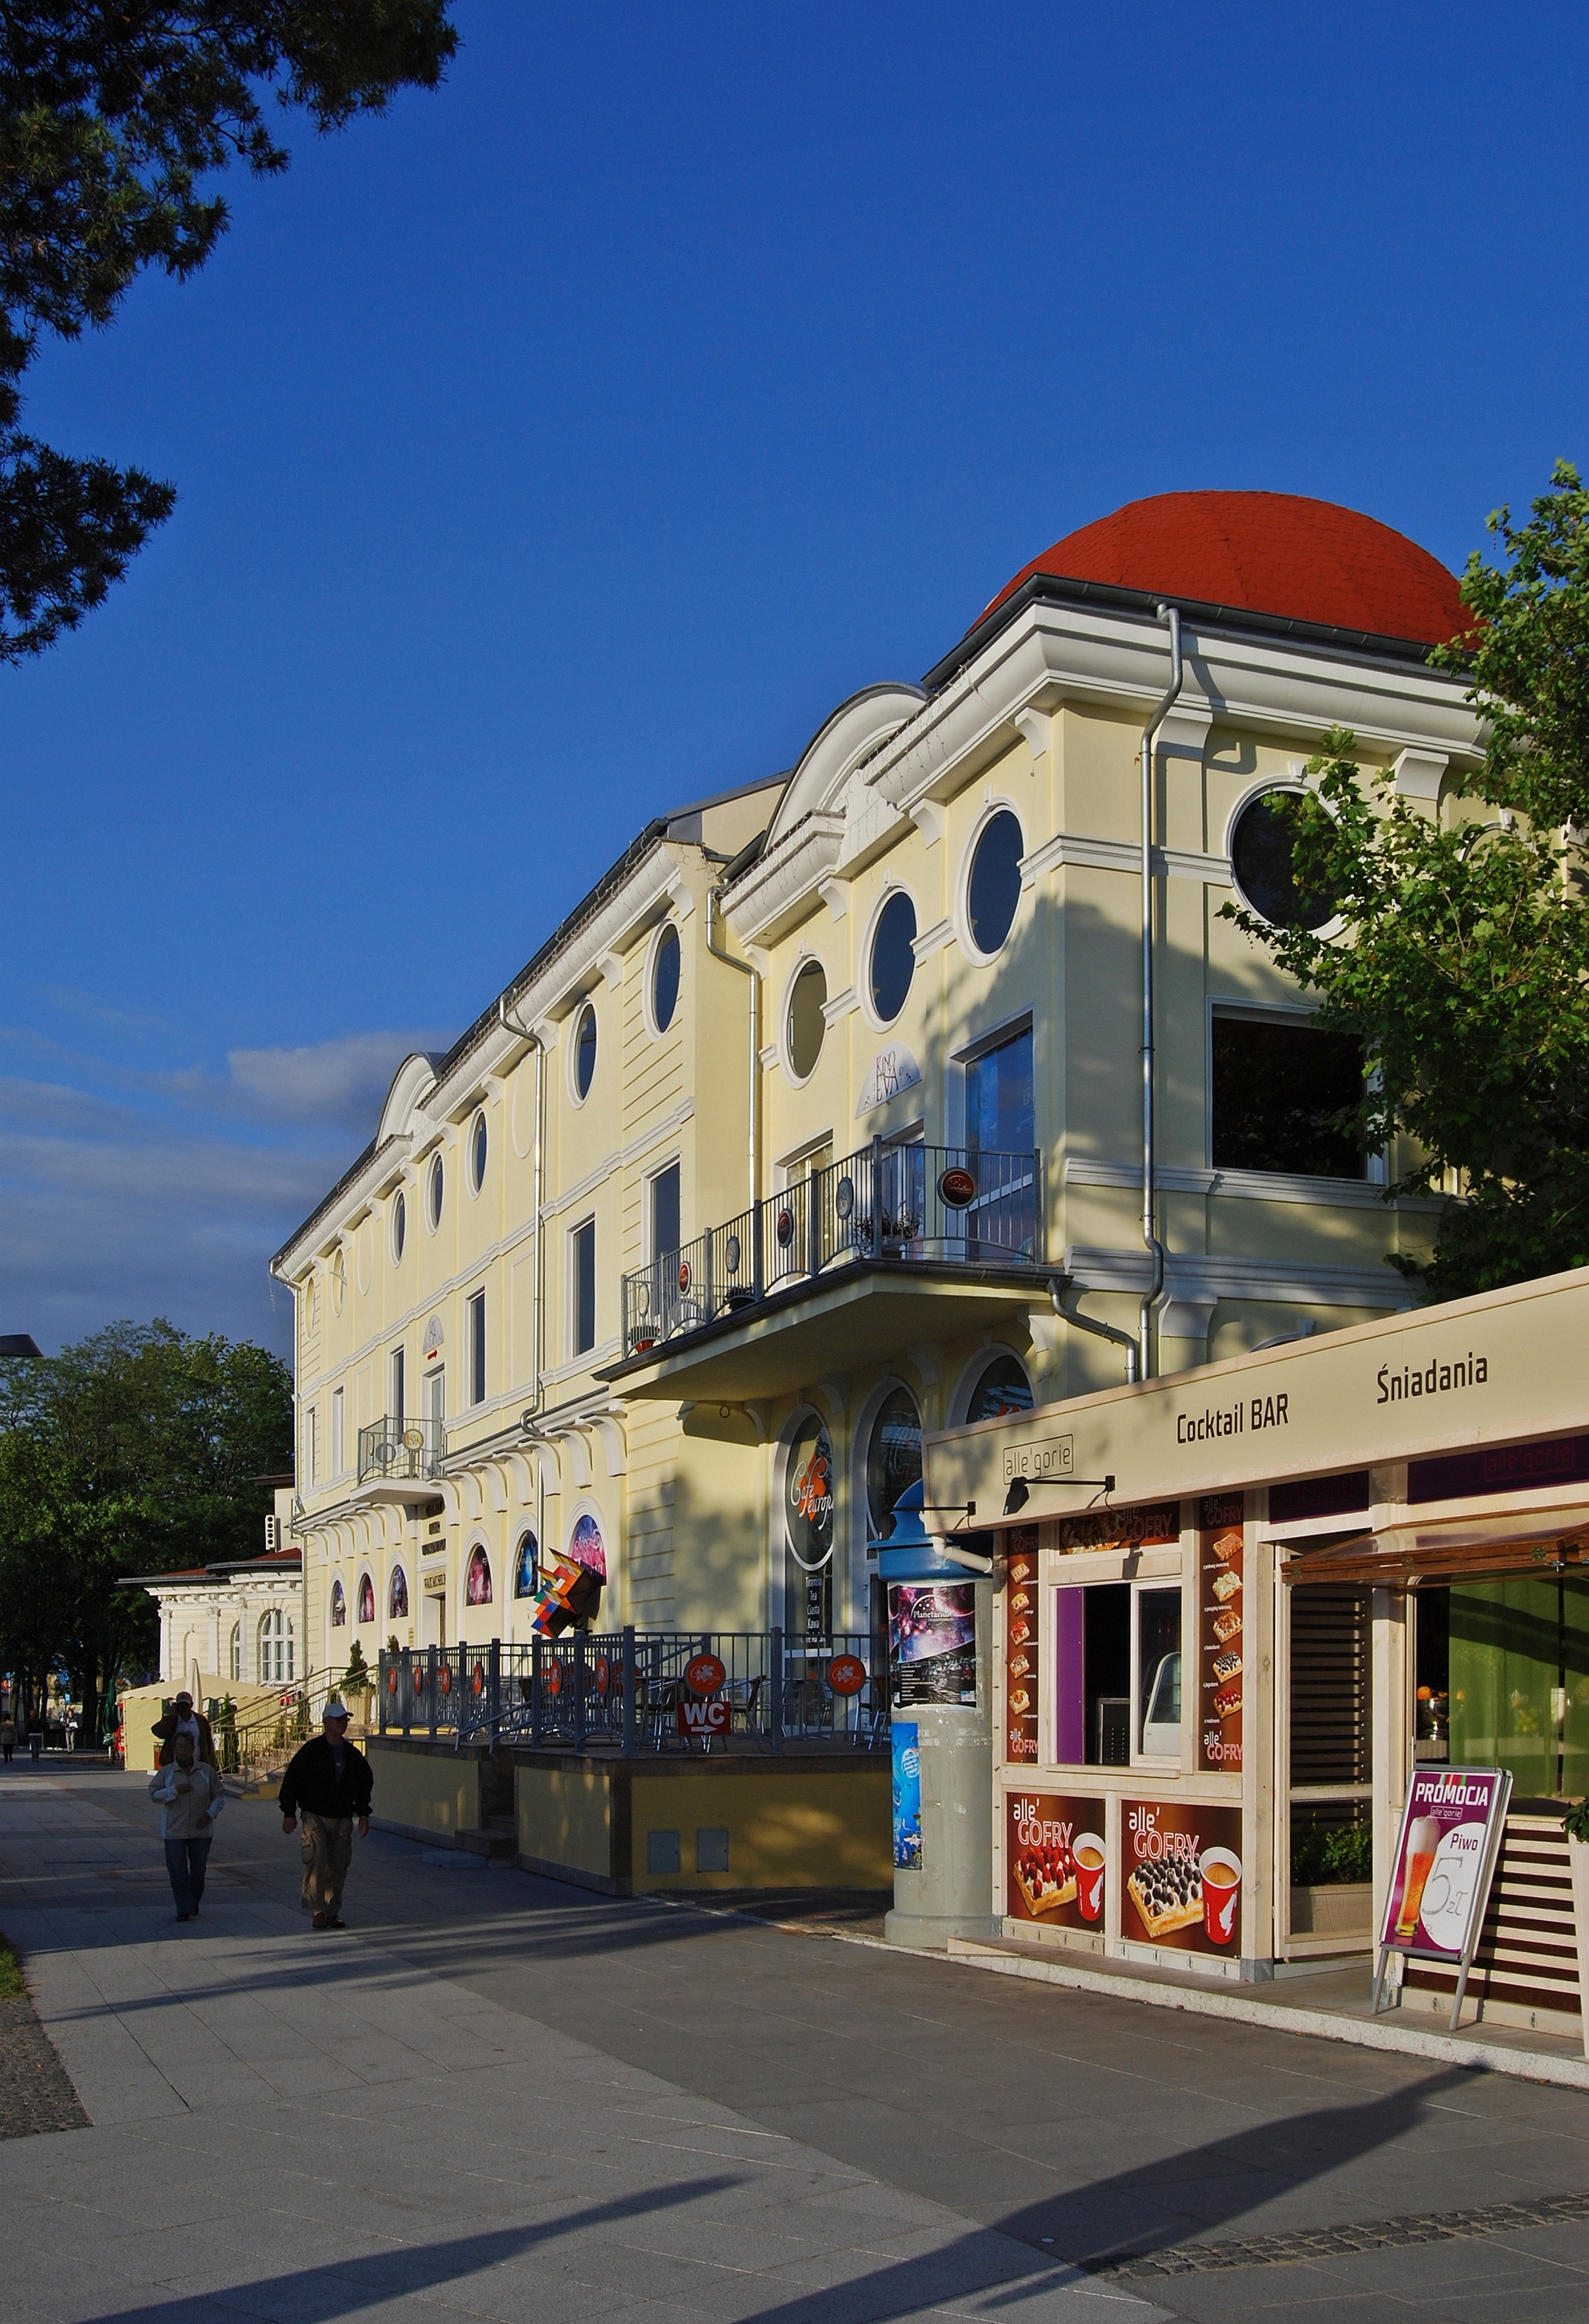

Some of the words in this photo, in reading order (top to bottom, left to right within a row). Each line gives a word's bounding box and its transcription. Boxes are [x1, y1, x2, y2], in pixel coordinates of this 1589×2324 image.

[1377, 1350, 1488, 1404] Śniadania
[1177, 1402, 1243, 1444] Cocktail
[1251, 1393, 1289, 1430] BAR
[1006, 1445, 1071, 1479] alle'gorie
[1207, 1503, 1243, 1525] GOFRY
[1123, 1514, 1172, 1540] GOFRY
[684, 1702, 725, 1725] WC
[1010, 1727, 1024, 1741] alle'
[1012, 1738, 1038, 1753] GOFRY
[1204, 1730, 1222, 1745] alle'
[1207, 1743, 1243, 1761] GOFRY
[1415, 1783, 1489, 1806] PROMOCJA
[1014, 1798, 1039, 1821] alle'
[1128, 1806, 1160, 1831] alle'
[1431, 1807, 1462, 1818] alle'gorie
[1017, 1820, 1073, 1849] GOFRY
[1134, 1830, 1200, 1862] GOFRY
[1450, 1833, 1478, 1851] Piwo
